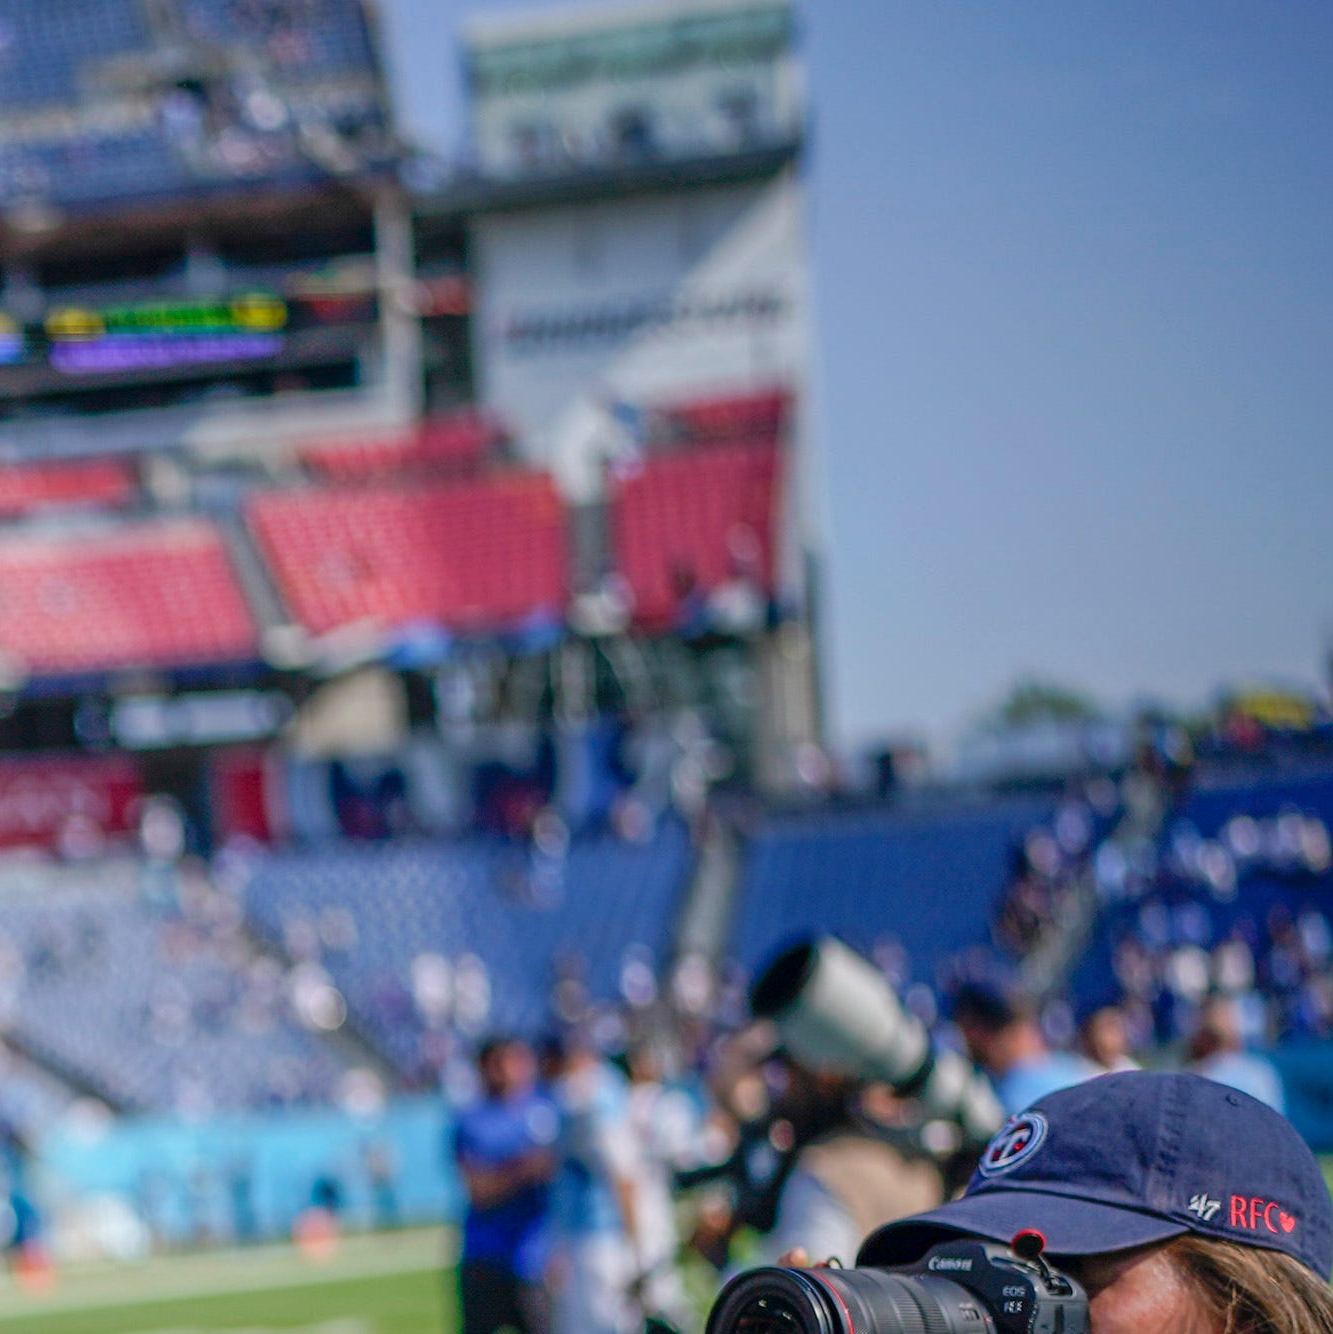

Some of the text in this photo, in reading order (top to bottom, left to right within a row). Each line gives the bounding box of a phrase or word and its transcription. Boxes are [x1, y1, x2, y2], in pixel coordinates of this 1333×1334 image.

[1230, 1194, 1279, 1234] RFC
[928, 1256, 973, 1271] Canon
[1002, 1285, 1026, 1297] EOS
